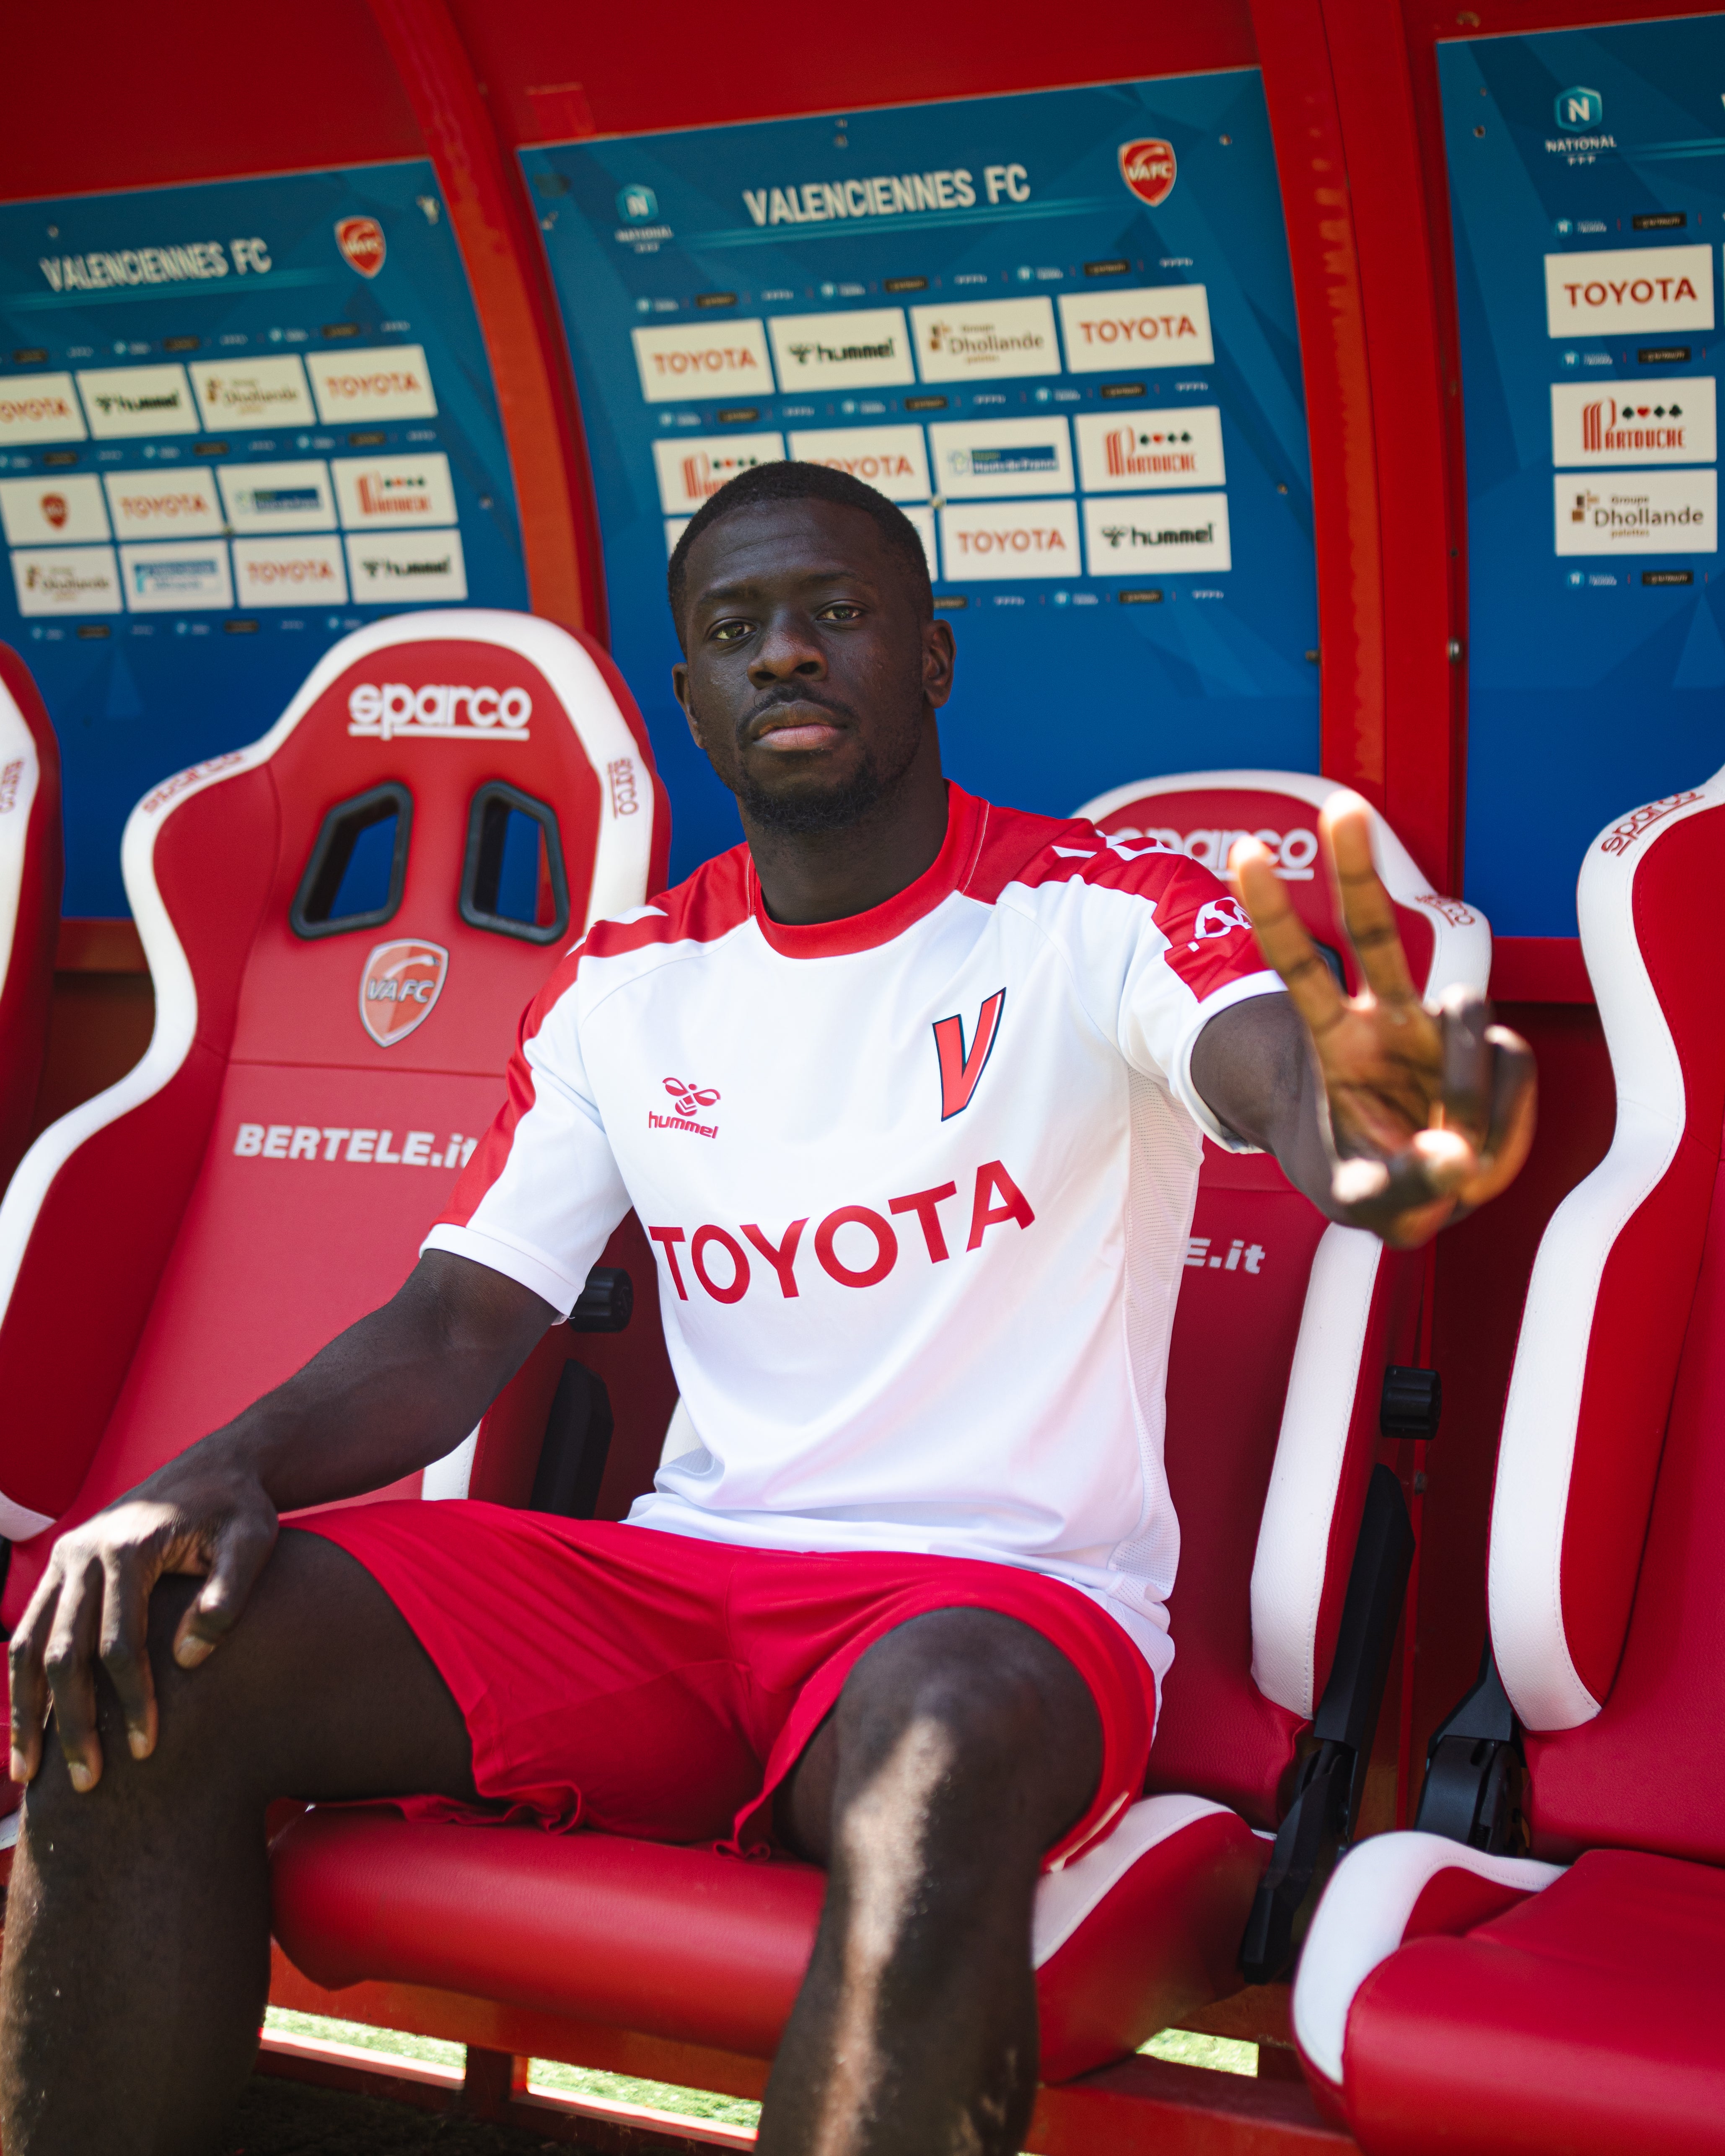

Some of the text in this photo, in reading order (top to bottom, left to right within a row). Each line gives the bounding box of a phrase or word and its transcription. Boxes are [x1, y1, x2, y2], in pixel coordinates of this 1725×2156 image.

[1544, 135, 1617, 153] NATIONAL
[1128, 161, 1173, 181] VAFC
[742, 163, 1031, 226] VALENCIENNES FC
[39, 237, 272, 292] VALENCIENNES FC
[1564, 276, 1698, 309] TOYOTA
[1080, 314, 1197, 344] TOYOTA
[817, 337, 894, 361] hummel
[950, 332, 1044, 355] Dhollande
[653, 349, 757, 374] TOYOTA
[326, 373, 420, 399] TOYOTA
[0, 398, 70, 422] OYOTA
[807, 454, 915, 478] OYOTA
[120, 492, 208, 519] TOYOTA
[1594, 505, 1704, 528] Dhollande
[958, 529, 1066, 554] TOYOTA
[1131, 522, 1213, 546] hummel
[248, 559, 335, 587] TOYOTA
[348, 682, 533, 741] sparco
[368, 978, 436, 1003] VAFC
[648, 1110, 719, 1139] hummel
[648, 1160, 1036, 1304] TOYOTA
